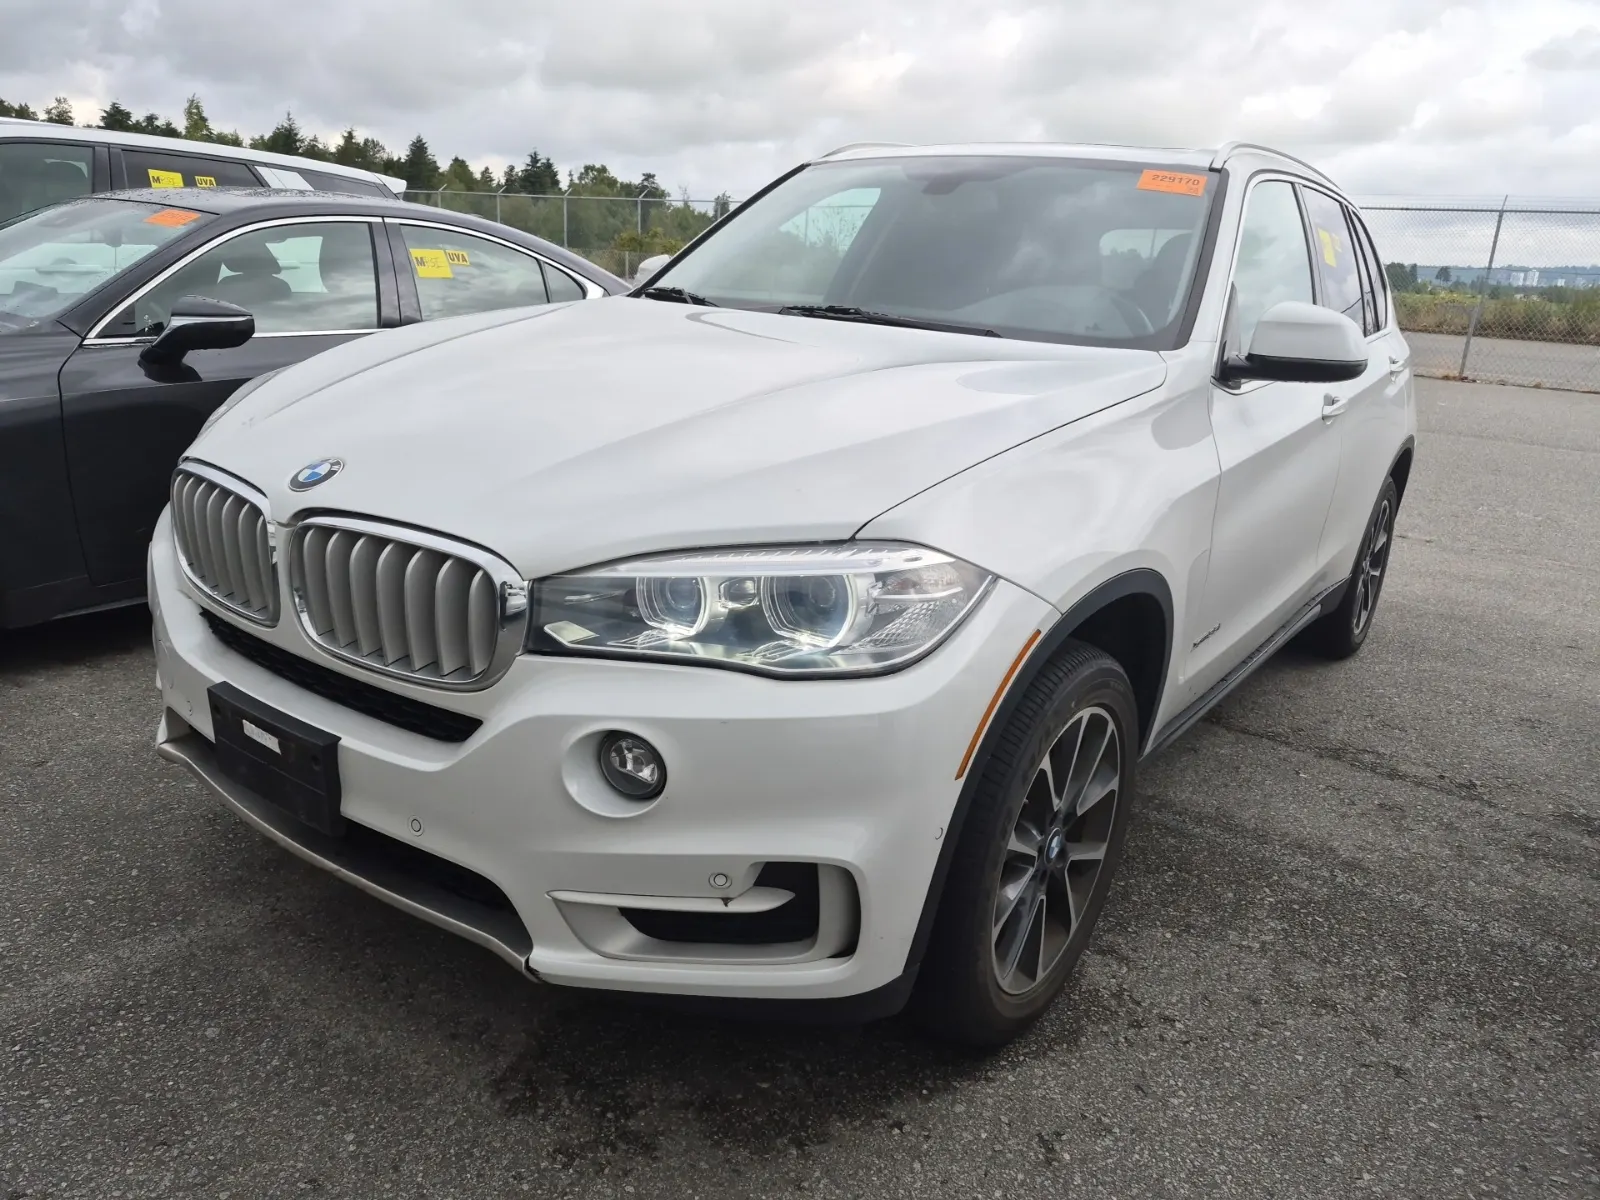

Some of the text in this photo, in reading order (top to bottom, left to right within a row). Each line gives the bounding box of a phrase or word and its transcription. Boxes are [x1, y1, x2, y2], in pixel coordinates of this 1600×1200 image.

[196, 177, 215, 187] UVA
[1151, 174, 1200, 186] 229170
[447, 252, 468, 263] UVA
